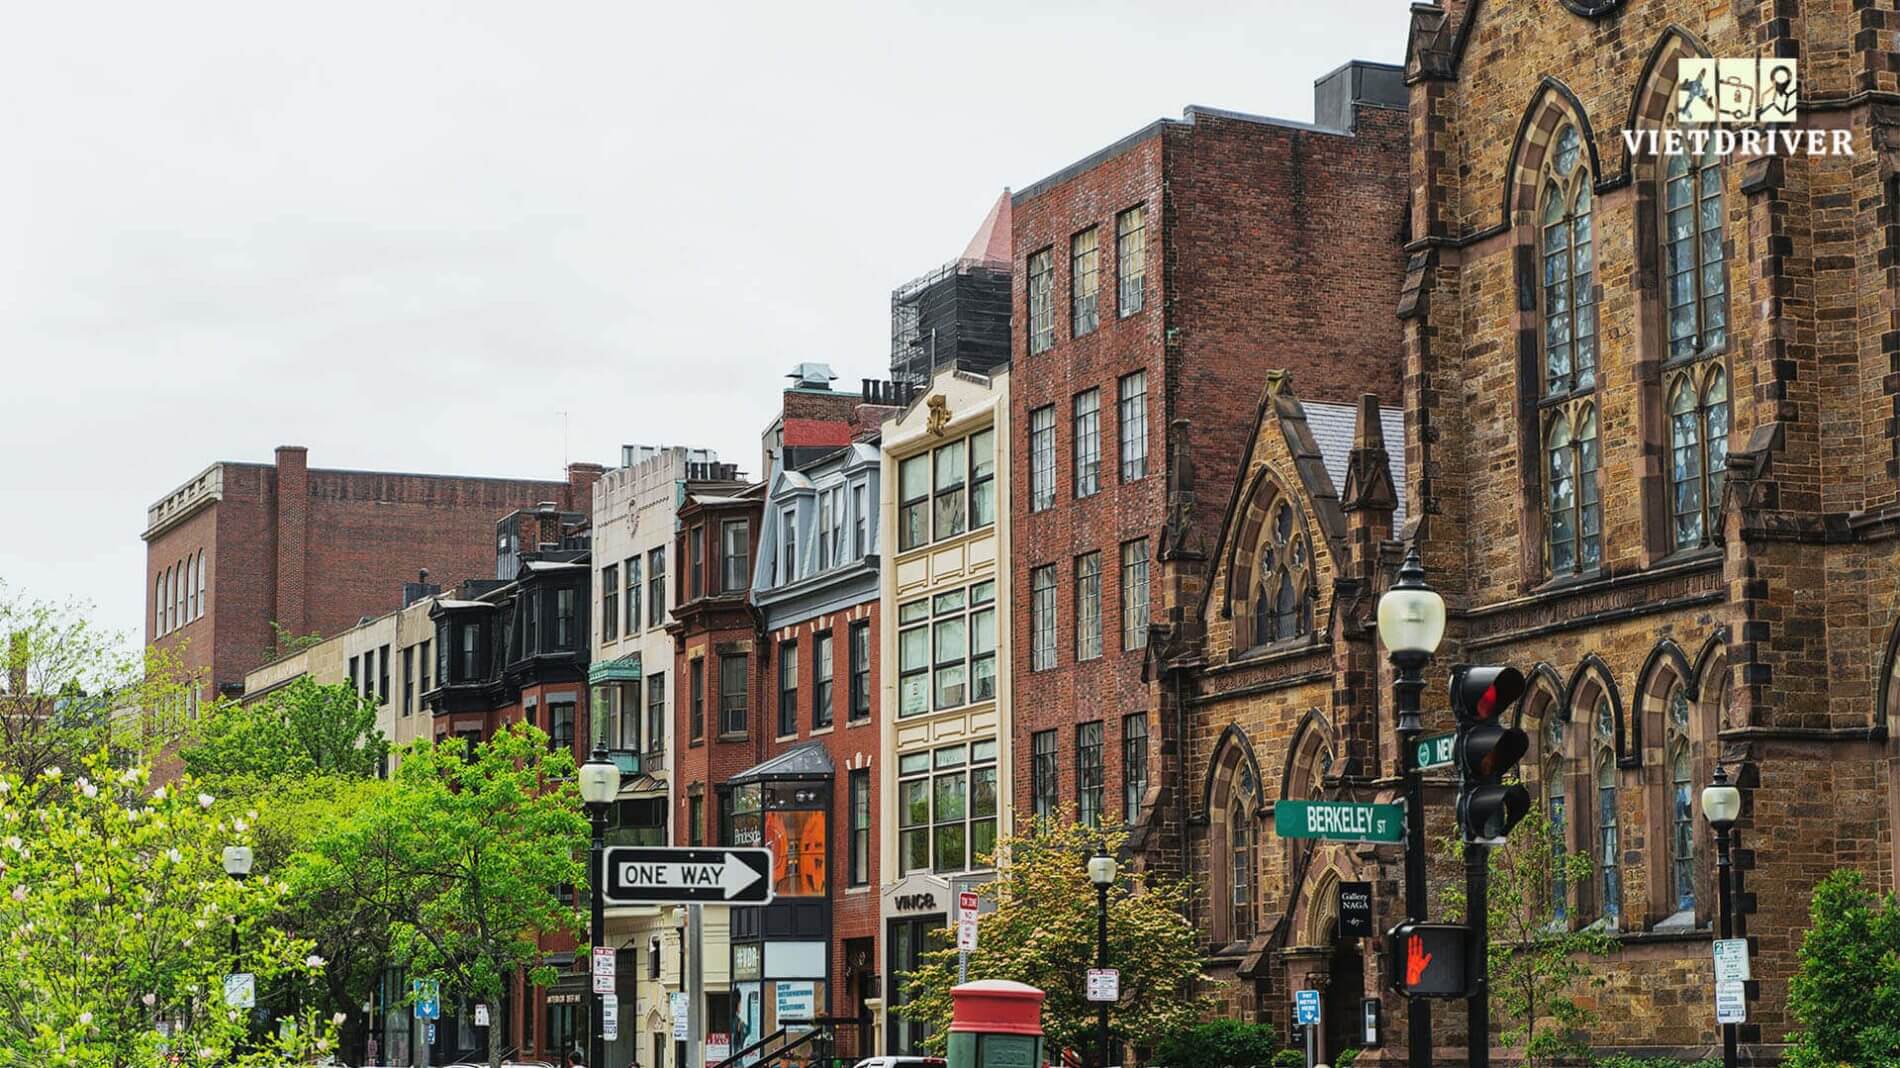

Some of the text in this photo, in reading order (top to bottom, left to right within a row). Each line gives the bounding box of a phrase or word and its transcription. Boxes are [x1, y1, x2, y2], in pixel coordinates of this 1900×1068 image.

[1306, 805, 1387, 834] BERKELEY ST
[625, 865, 724, 885] ONE WAY
[1341, 892, 1369, 903] Gallery
[1342, 901, 1369, 910] NAGA
